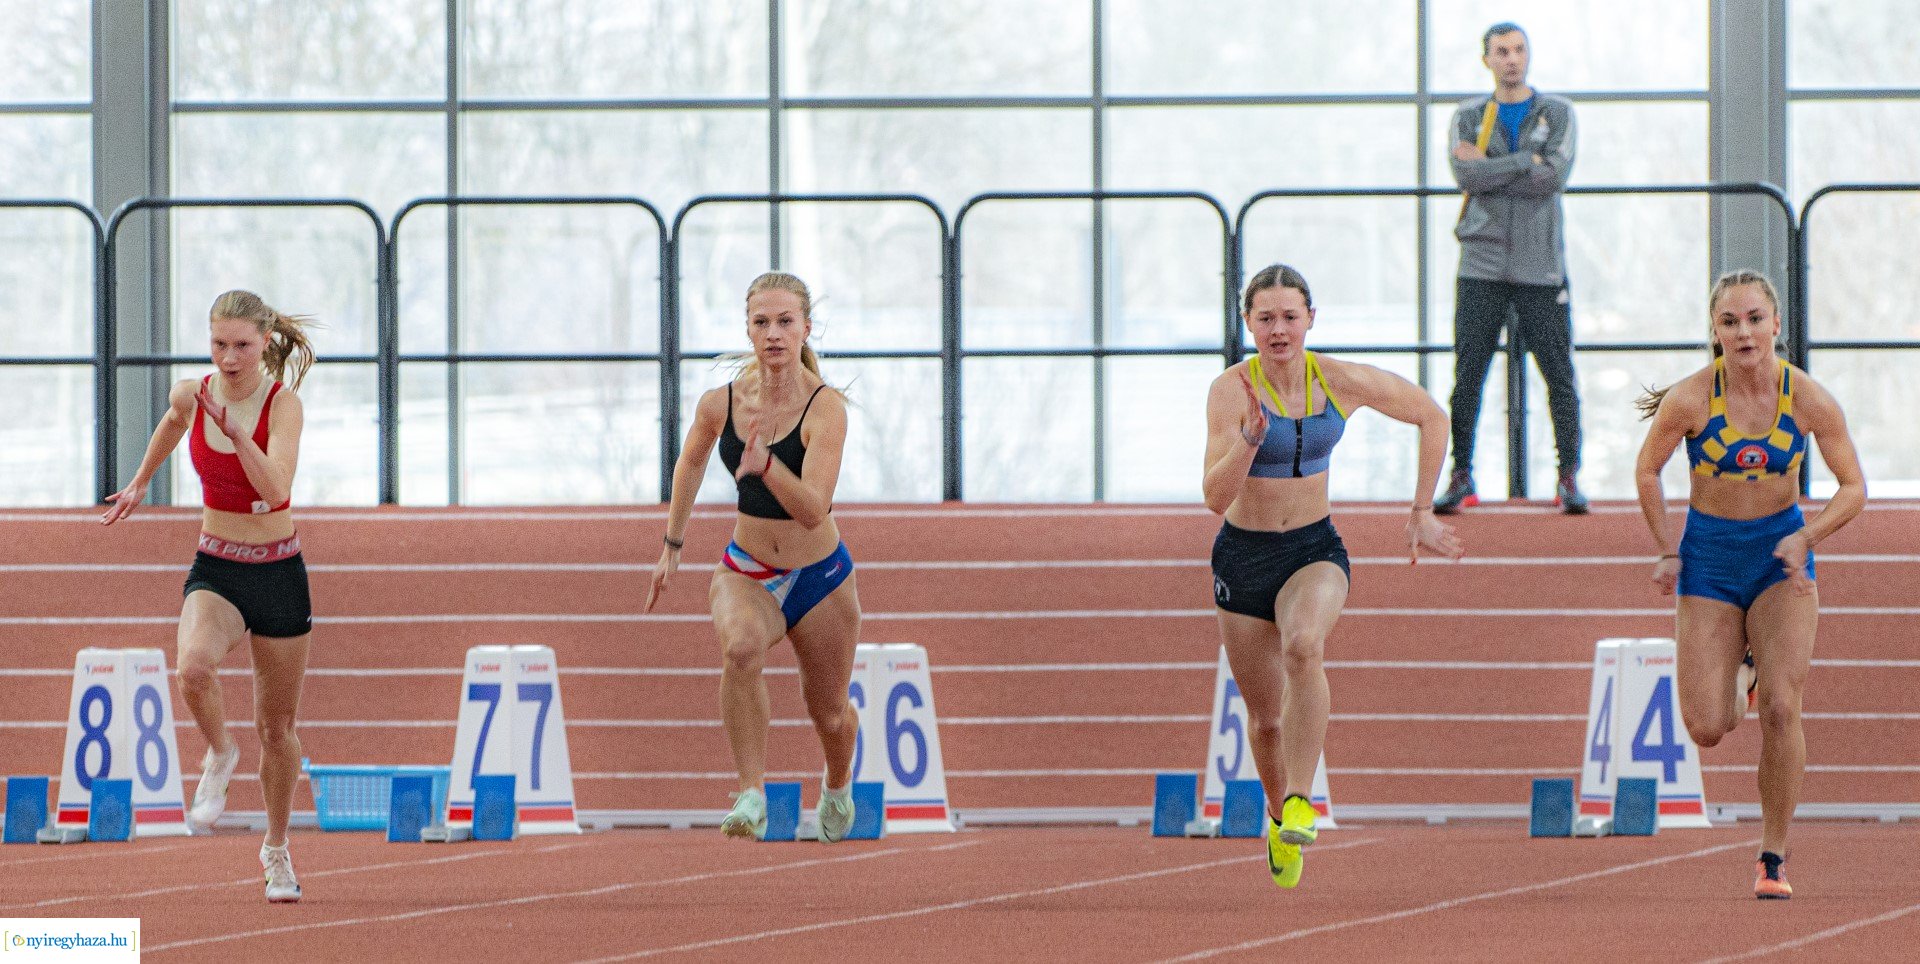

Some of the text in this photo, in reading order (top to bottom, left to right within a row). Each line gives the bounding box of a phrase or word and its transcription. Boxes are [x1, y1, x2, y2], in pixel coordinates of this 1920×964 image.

[222, 543, 269, 560] PRO
[75, 684, 112, 791] 8
[133, 684, 169, 791] 8
[468, 684, 501, 789] 7
[517, 684, 553, 789] 7
[886, 681, 928, 788] 6
[1217, 679, 1244, 782] 5
[1590, 675, 1613, 784] 4
[1632, 674, 1685, 784] 4
